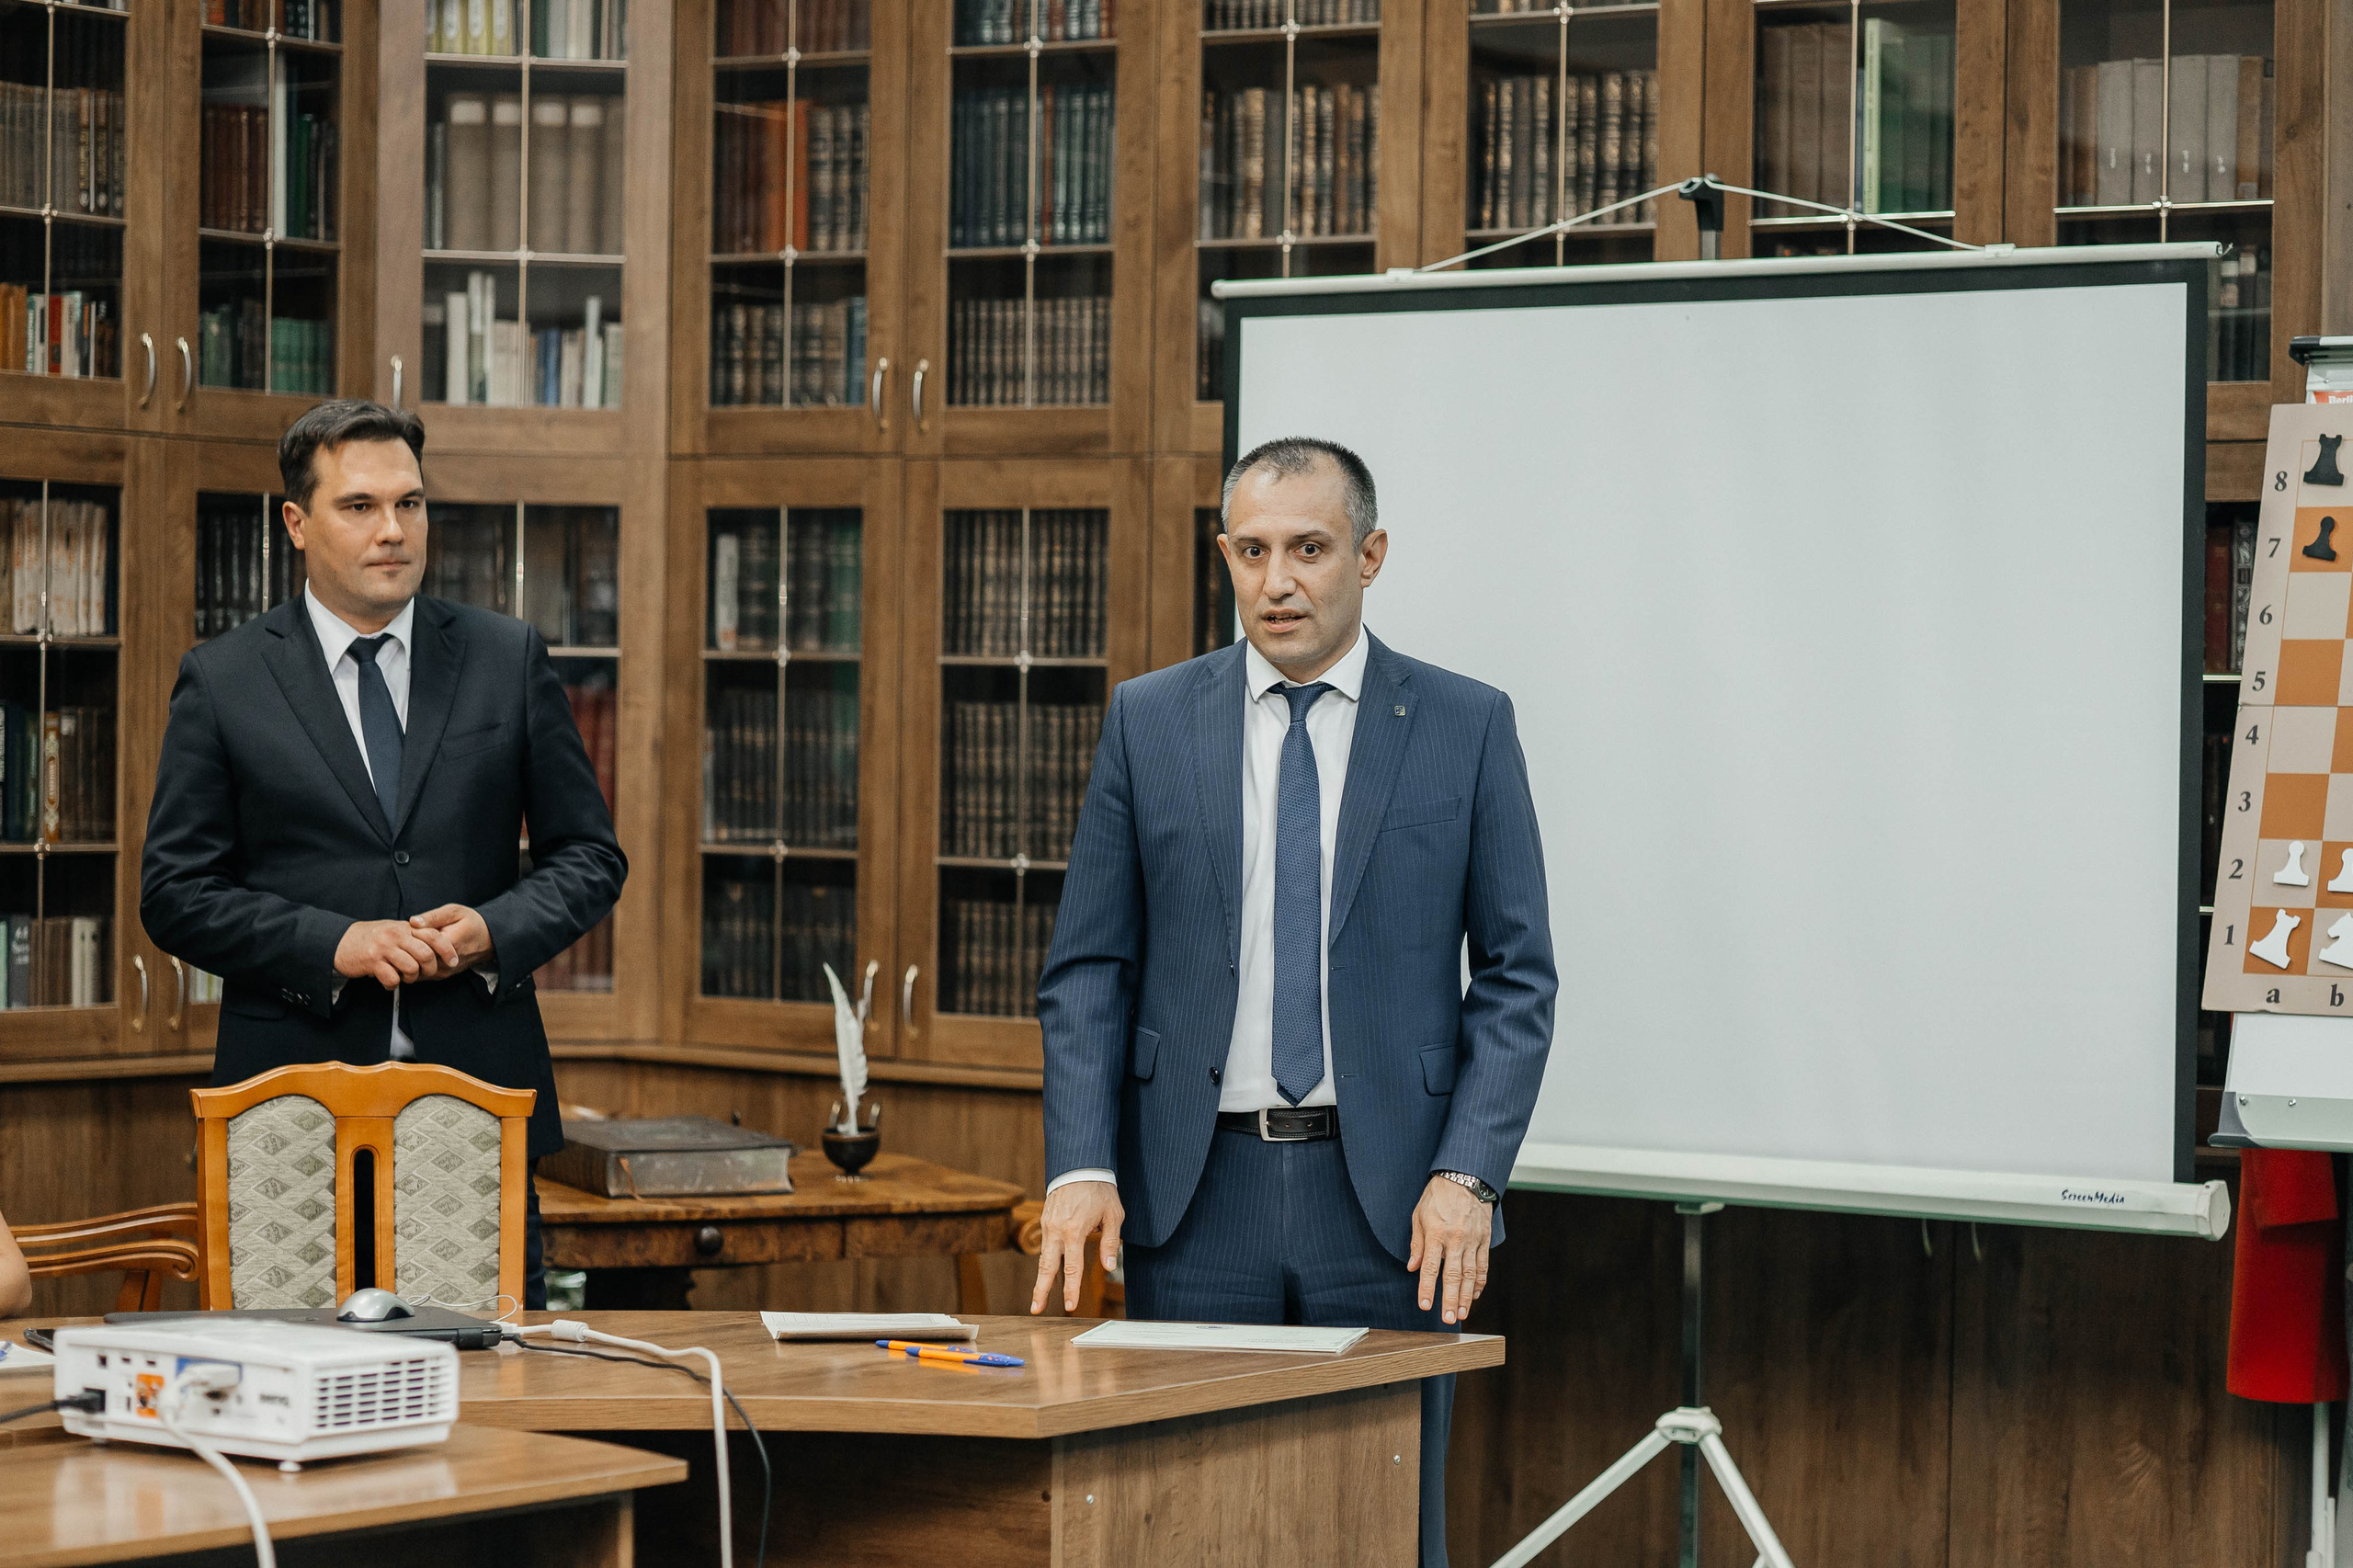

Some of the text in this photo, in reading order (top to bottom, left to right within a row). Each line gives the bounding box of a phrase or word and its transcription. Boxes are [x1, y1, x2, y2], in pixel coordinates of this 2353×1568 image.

[2274, 471, 2288, 492] 8
[2268, 538, 2281, 558] 7
[2258, 604, 2273, 625] 6
[2252, 671, 2267, 691] 5
[2245, 724, 2259, 745] 4
[2237, 790, 2252, 812] 3
[2228, 858, 2244, 880] 2
[2224, 924, 2234, 946] 1
[2266, 983, 2345, 1007] a b
[2061, 1188, 2125, 1205] ScreenMedia
